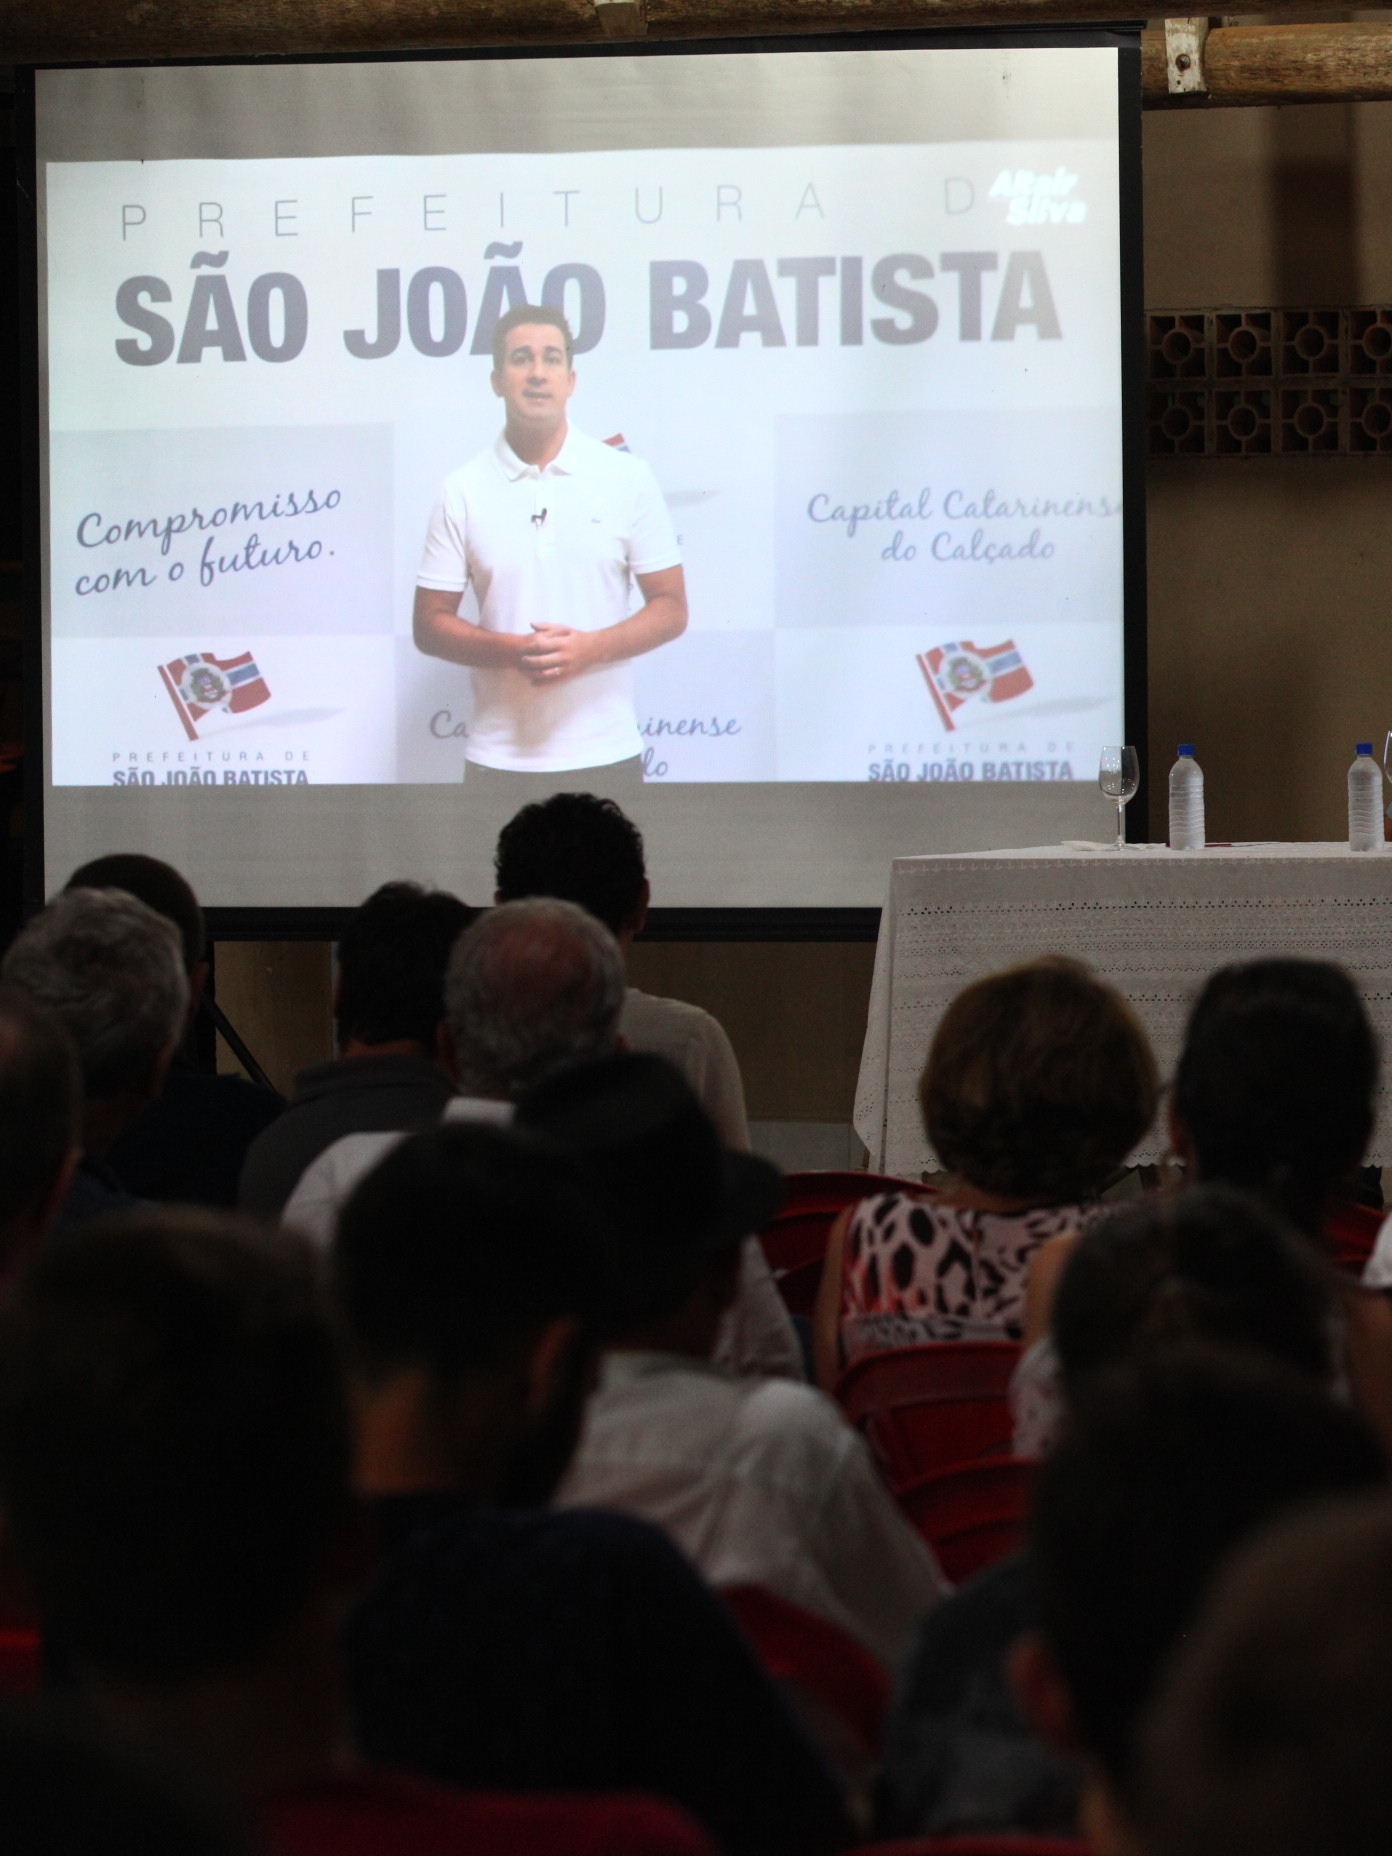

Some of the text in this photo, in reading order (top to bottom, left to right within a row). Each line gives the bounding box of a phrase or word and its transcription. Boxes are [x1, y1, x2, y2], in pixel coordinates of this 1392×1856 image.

[120, 180, 826, 241] PREFEITURA
[1006, 196, 1087, 226] Silva
[114, 241, 1063, 366] SÃO JOÃO BATISTA
[76, 489, 342, 556] Compromisso
[806, 487, 934, 538] Capital
[880, 529, 1056, 566] do Calçado
[75, 533, 336, 597] com o futuro.
[637, 715, 742, 737] inense
[112, 750, 310, 763] PREFEITURA DE
[867, 741, 1074, 755] PREFEITURA DE
[112, 766, 310, 785] SÃO JOÃO BATISTA
[867, 757, 1075, 782] SÃO JOÃO BATISTA
